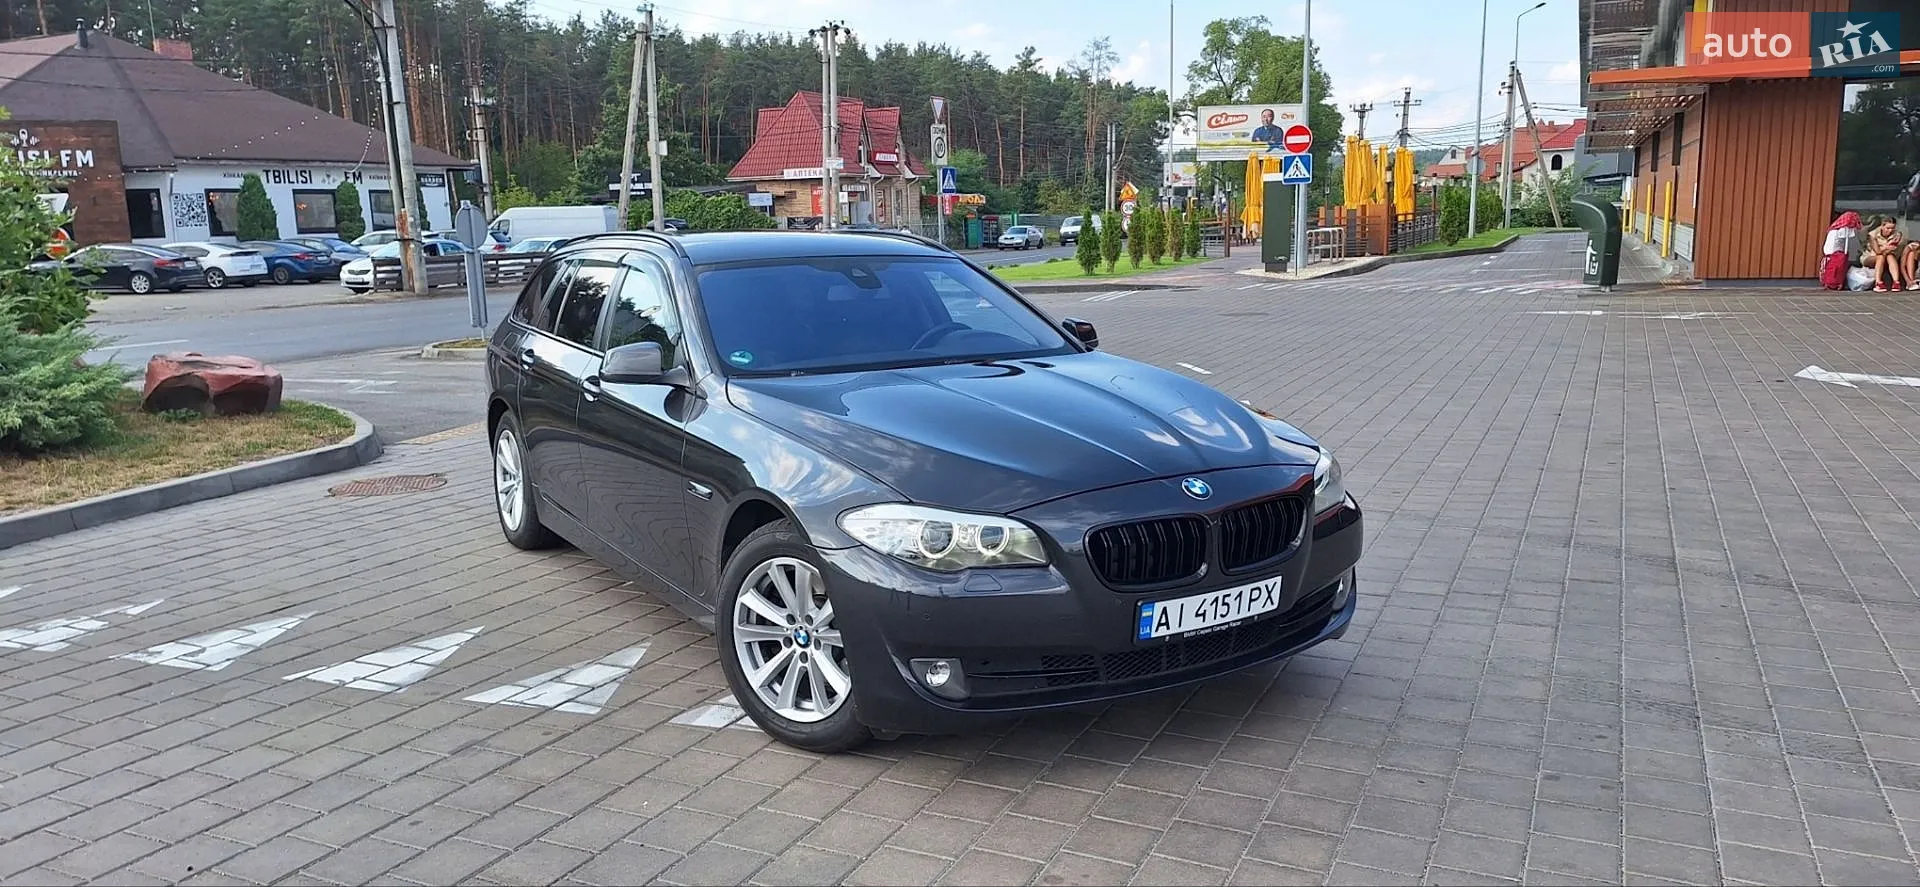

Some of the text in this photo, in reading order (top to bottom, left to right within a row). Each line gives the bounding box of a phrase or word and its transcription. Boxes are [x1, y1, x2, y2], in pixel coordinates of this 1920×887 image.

[60, 149, 94, 168] FM
[263, 169, 363, 184] TBILISI FM
[1155, 581, 1278, 633] AI 4151 PX
[1140, 627, 1151, 635] UA
